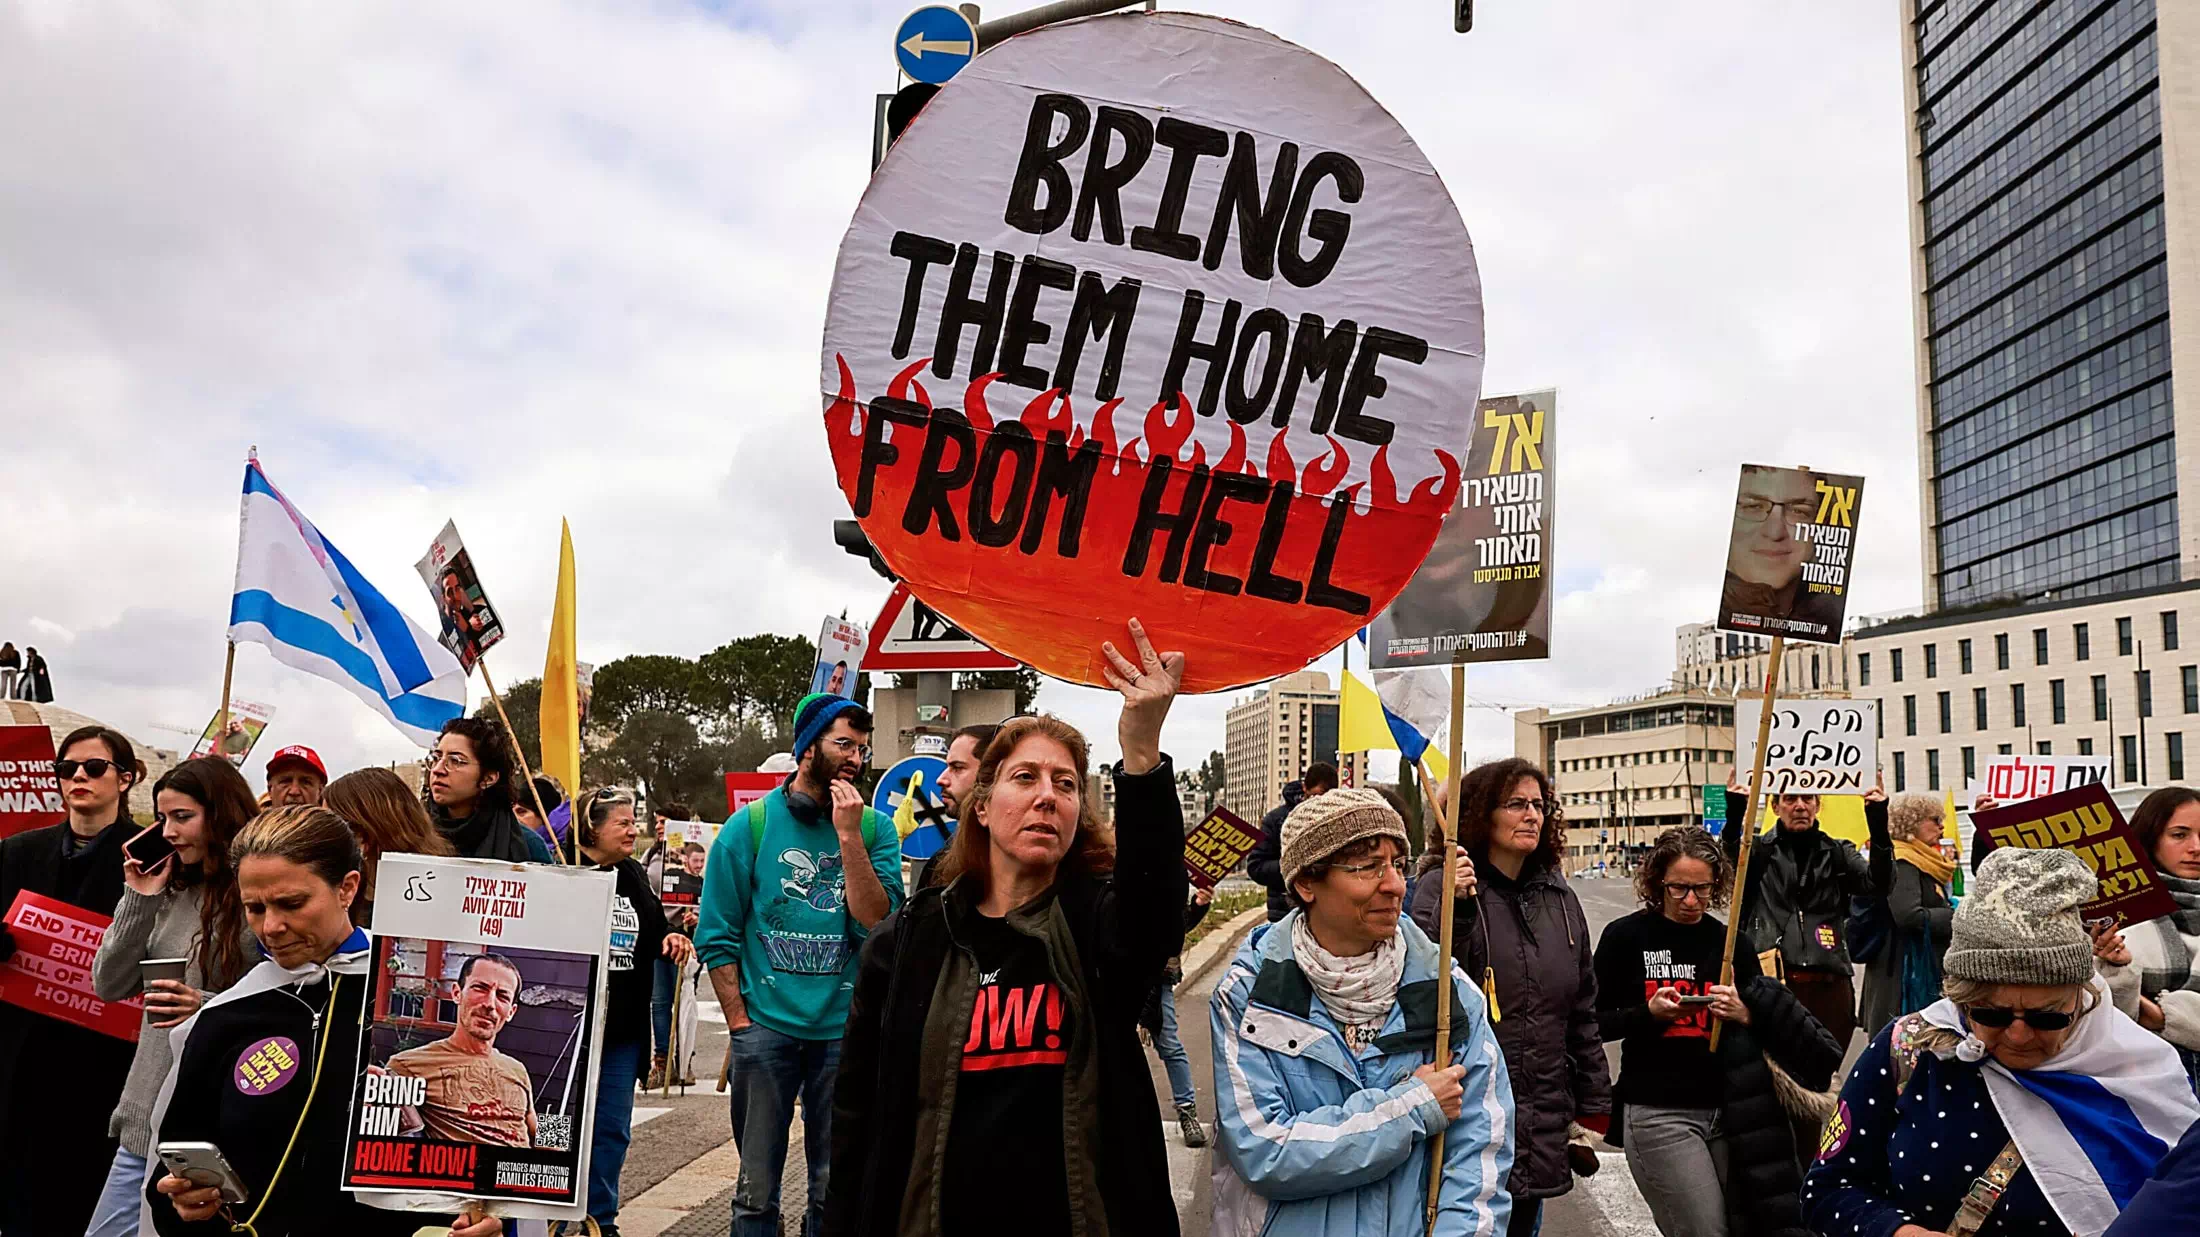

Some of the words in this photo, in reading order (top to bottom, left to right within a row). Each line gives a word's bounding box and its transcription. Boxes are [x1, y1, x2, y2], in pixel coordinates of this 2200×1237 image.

[1004, 93, 1364, 288] BRING
[890, 230, 1143, 402] THEM
[1160, 290, 1428, 445] HOME
[1484, 409, 1545, 475] אל
[1462, 472, 1543, 508] תשאירו
[1815, 480, 1856, 527] אל
[853, 396, 1103, 558] FROM
[1121, 455, 1371, 615] HELL
[1493, 502, 1542, 534] אותי
[1794, 522, 1850, 547] תשאירו
[1474, 533, 1541, 567] מאחור
[1815, 544, 1849, 566] אותי
[1473, 567, 1512, 584] מנגיסטו
[1514, 564, 1541, 580] אברה
[1800, 562, 1845, 586] מאחור
[0, 760, 17, 773] ND
[17, 760, 56, 773] THIS
[0, 791, 66, 813] WAR
[1203, 815, 1257, 852] עסקה
[1988, 802, 2113, 849] עסקה
[1187, 830, 1241, 868] מלאה
[2063, 836, 2138, 876] מל
[1204, 862, 1226, 879] ולא
[2099, 868, 2151, 897] ולא
[466, 876, 498, 896] אצילי
[499, 880, 527, 899] אביב
[462, 896, 489, 915] AVIV
[490, 899, 525, 919] ATZILI
[611, 914, 636, 928] השב
[19, 910, 64, 934] END
[71, 924, 105, 946] THI
[479, 916, 502, 938] (49)
[770, 930, 844, 940] CHARLOTT
[13, 953, 48, 977] ALL
[54, 968, 84, 985] OF
[48, 942, 94, 968] BRI
[1643, 950, 1672, 966] BRING
[1645, 964, 1670, 979] THEM
[1670, 964, 1696, 980] HOME
[35, 983, 106, 1017] HOME
[964, 984, 1064, 1053] W!
[248, 1050, 281, 1083] מלאה
[262, 1040, 295, 1070] עסקה
[364, 1074, 427, 1106] BRING
[359, 1105, 401, 1137] HIM
[354, 1140, 417, 1173] HOME
[419, 1144, 476, 1178] NOW!
[496, 1161, 528, 1173] HOSTAGES
[529, 1164, 542, 1174] AND
[542, 1164, 570, 1177] MISSING
[495, 1171, 536, 1188] FAMILIES
[537, 1174, 569, 1191] FORUM
